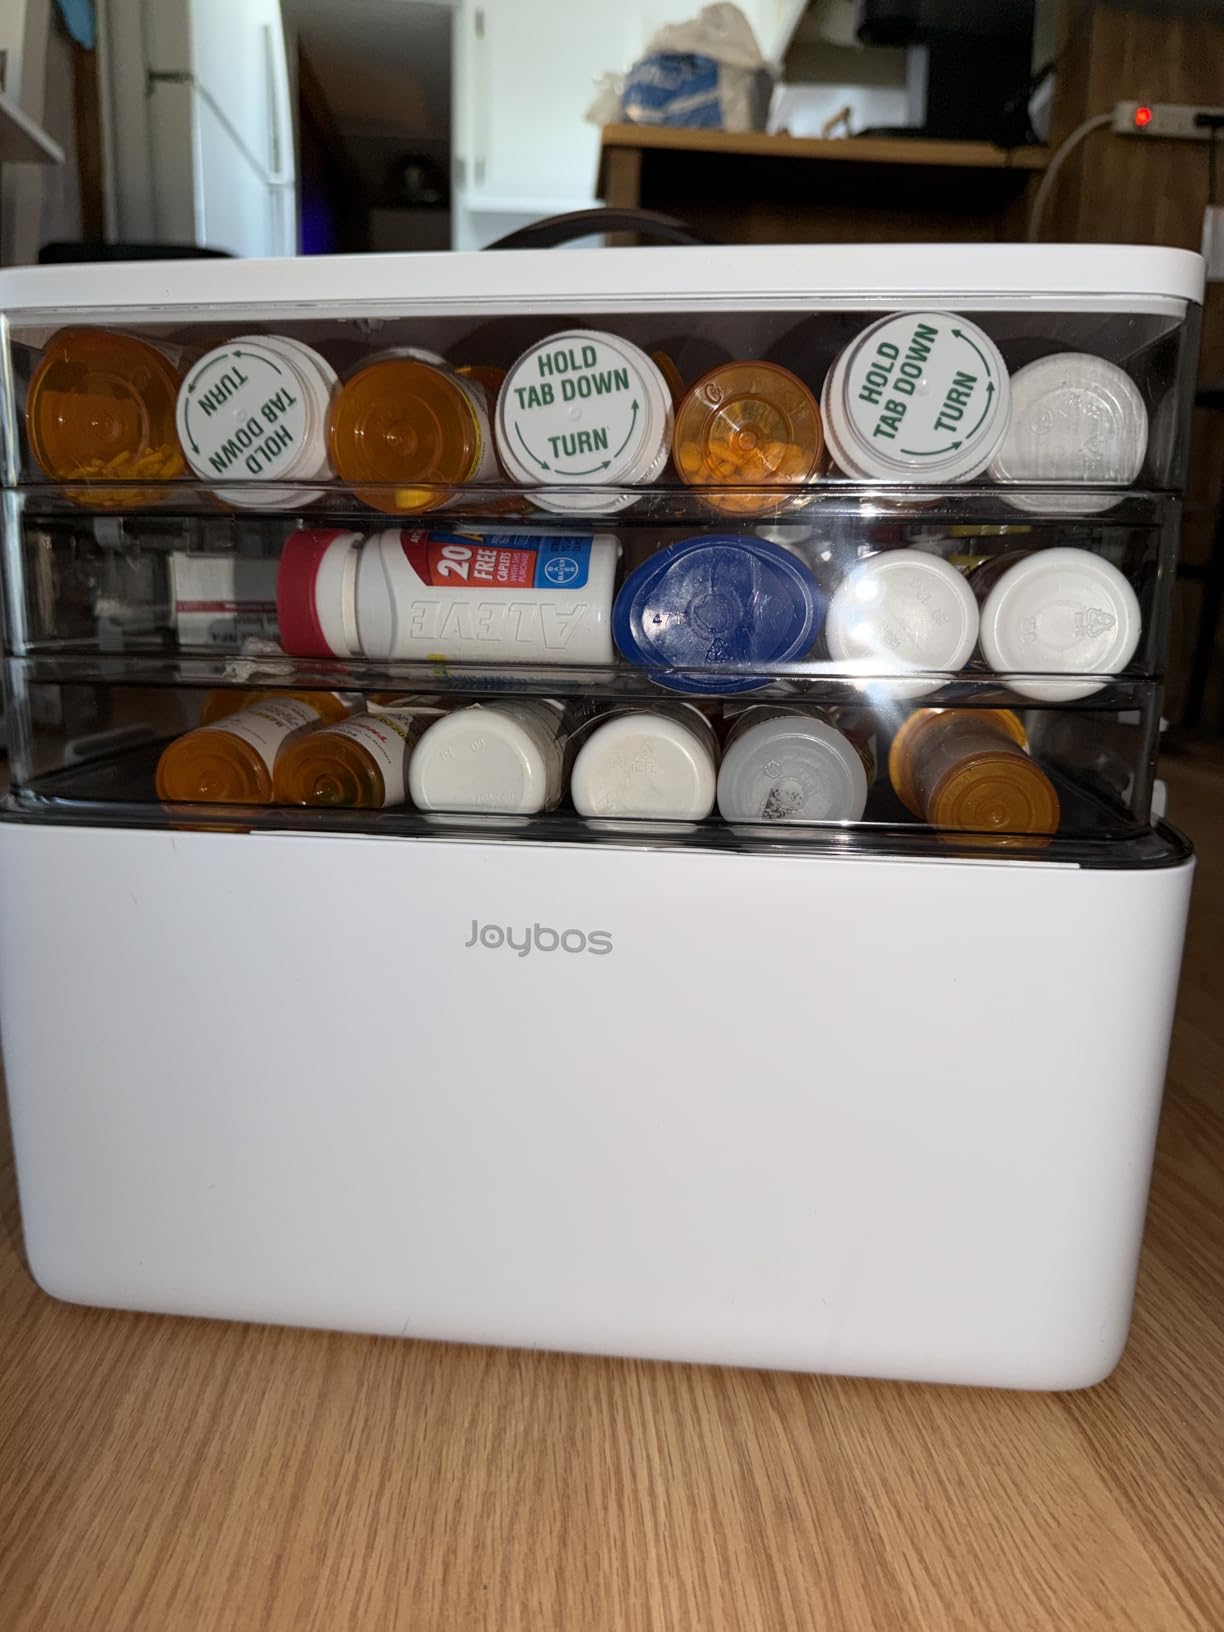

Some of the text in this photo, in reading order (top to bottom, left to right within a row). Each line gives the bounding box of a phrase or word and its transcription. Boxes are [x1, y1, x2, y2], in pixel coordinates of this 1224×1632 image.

[537, 345, 598, 378] HOLD
[858, 341, 900, 405] HOLD
[197, 366, 248, 417] TURN
[514, 367, 630, 410] TAB DOWN
[872, 323, 939, 440] TAB DOWN
[933, 370, 978, 432] TURN
[208, 387, 297, 474] TAB DOWN
[245, 424, 294, 474] HOLD
[547, 427, 609, 459] TURN
[437, 546, 473, 581] 20
[474, 549, 498, 581] FREE
[497, 552, 511, 582] CAPLETS
[510, 564, 519, 582] WITH
[518, 552, 529, 582] PURCHASE
[557, 558, 566, 582] BAYER
[410, 600, 588, 650] ALEVE
[465, 919, 614, 958] Joybos
